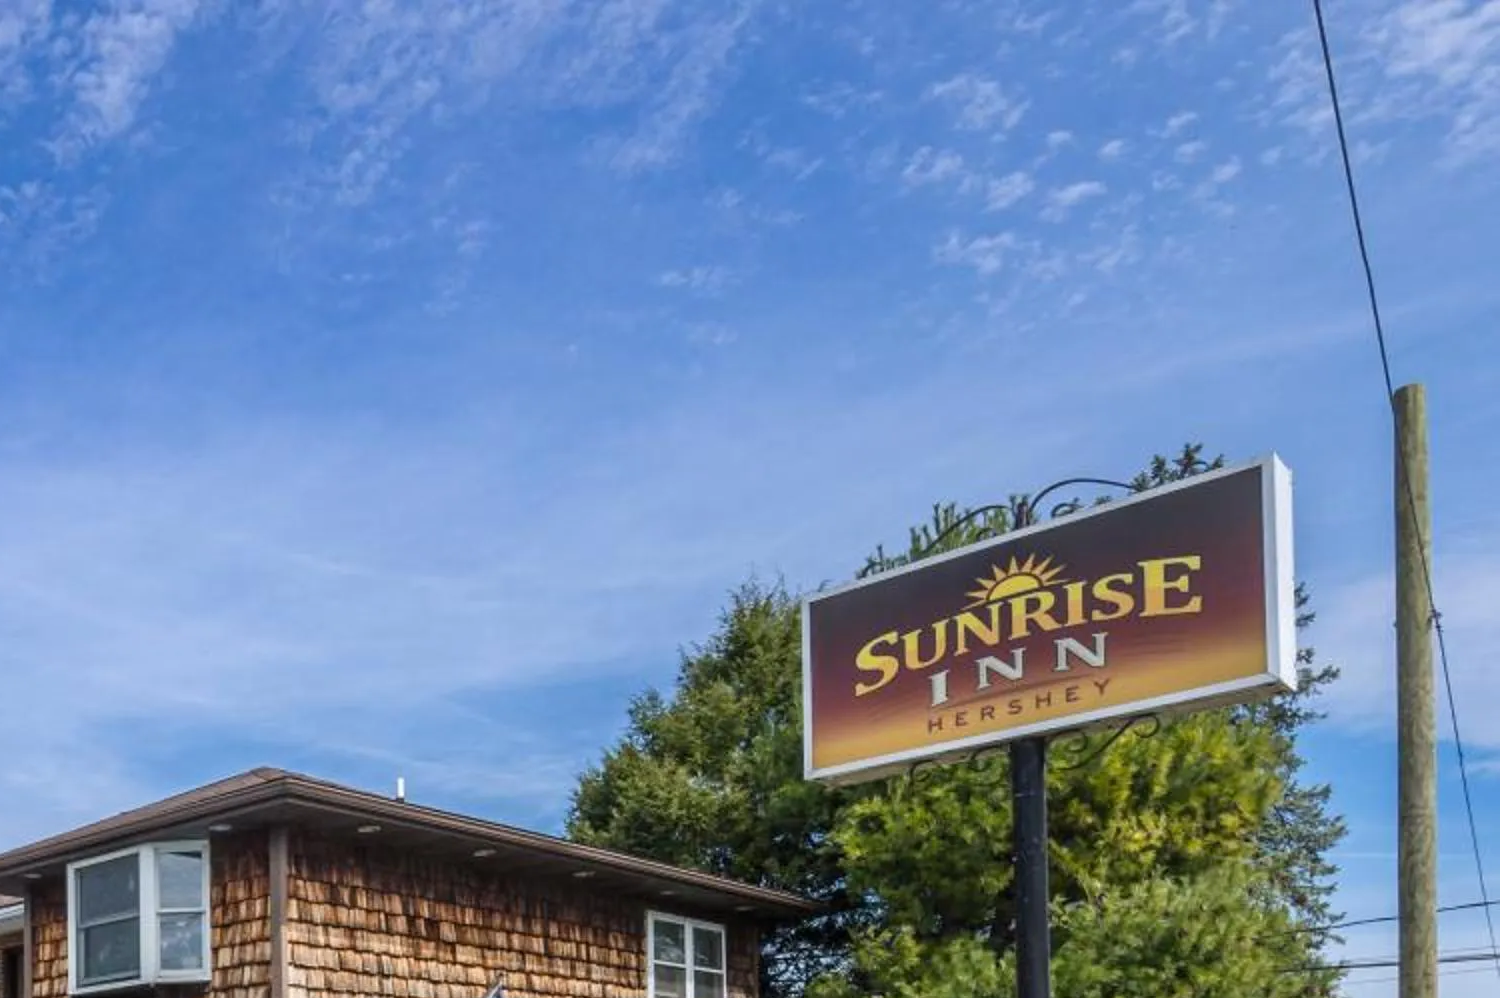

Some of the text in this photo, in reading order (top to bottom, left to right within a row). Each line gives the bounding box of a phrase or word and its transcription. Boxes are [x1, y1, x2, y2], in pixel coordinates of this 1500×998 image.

[854, 555, 1202, 696] SUNRISE
[927, 677, 1111, 734] HERSHEY
[928, 632, 1108, 707] INN
